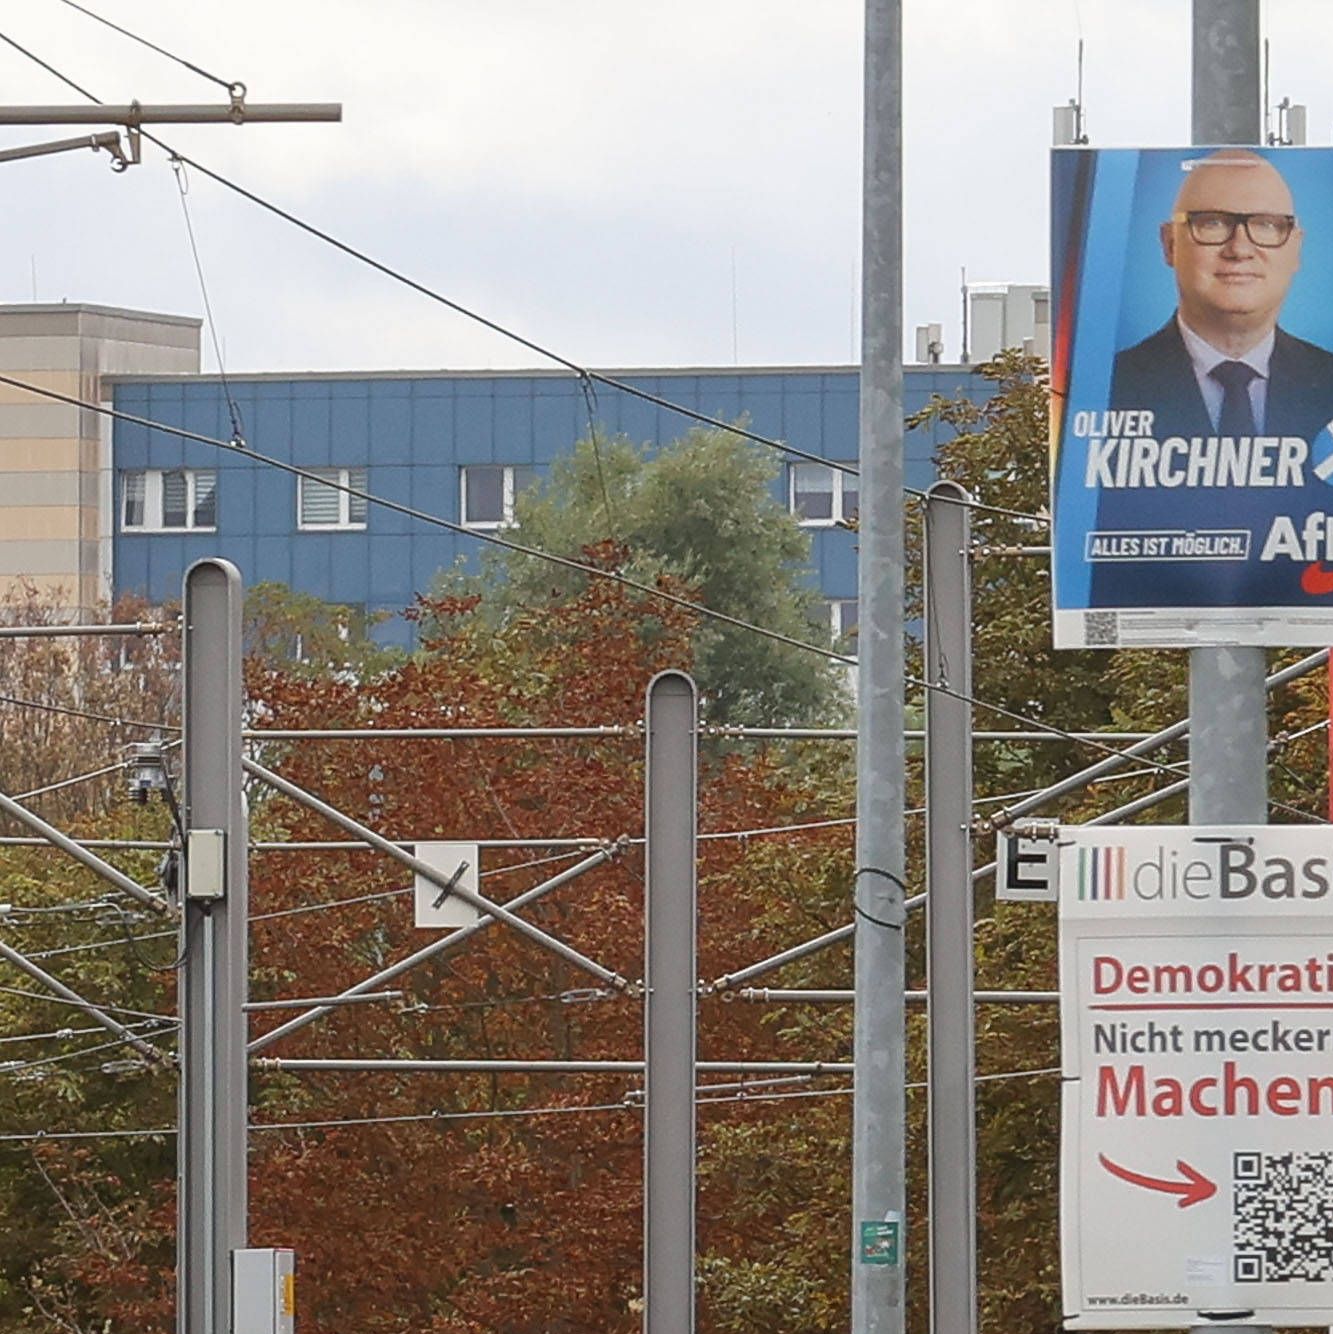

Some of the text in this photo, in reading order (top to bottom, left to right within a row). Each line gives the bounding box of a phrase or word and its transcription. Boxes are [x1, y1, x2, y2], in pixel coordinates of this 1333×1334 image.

[1074, 410, 1155, 438] OLIVER
[1085, 437, 1308, 488] KIRCHNER
[1092, 530, 1246, 556] ALLES IST MÖGLICH.
[1007, 836, 1048, 890] E
[1094, 1023, 1183, 1054] Nicht
[1087, 1293, 1190, 1305] www.dieBasis.de
